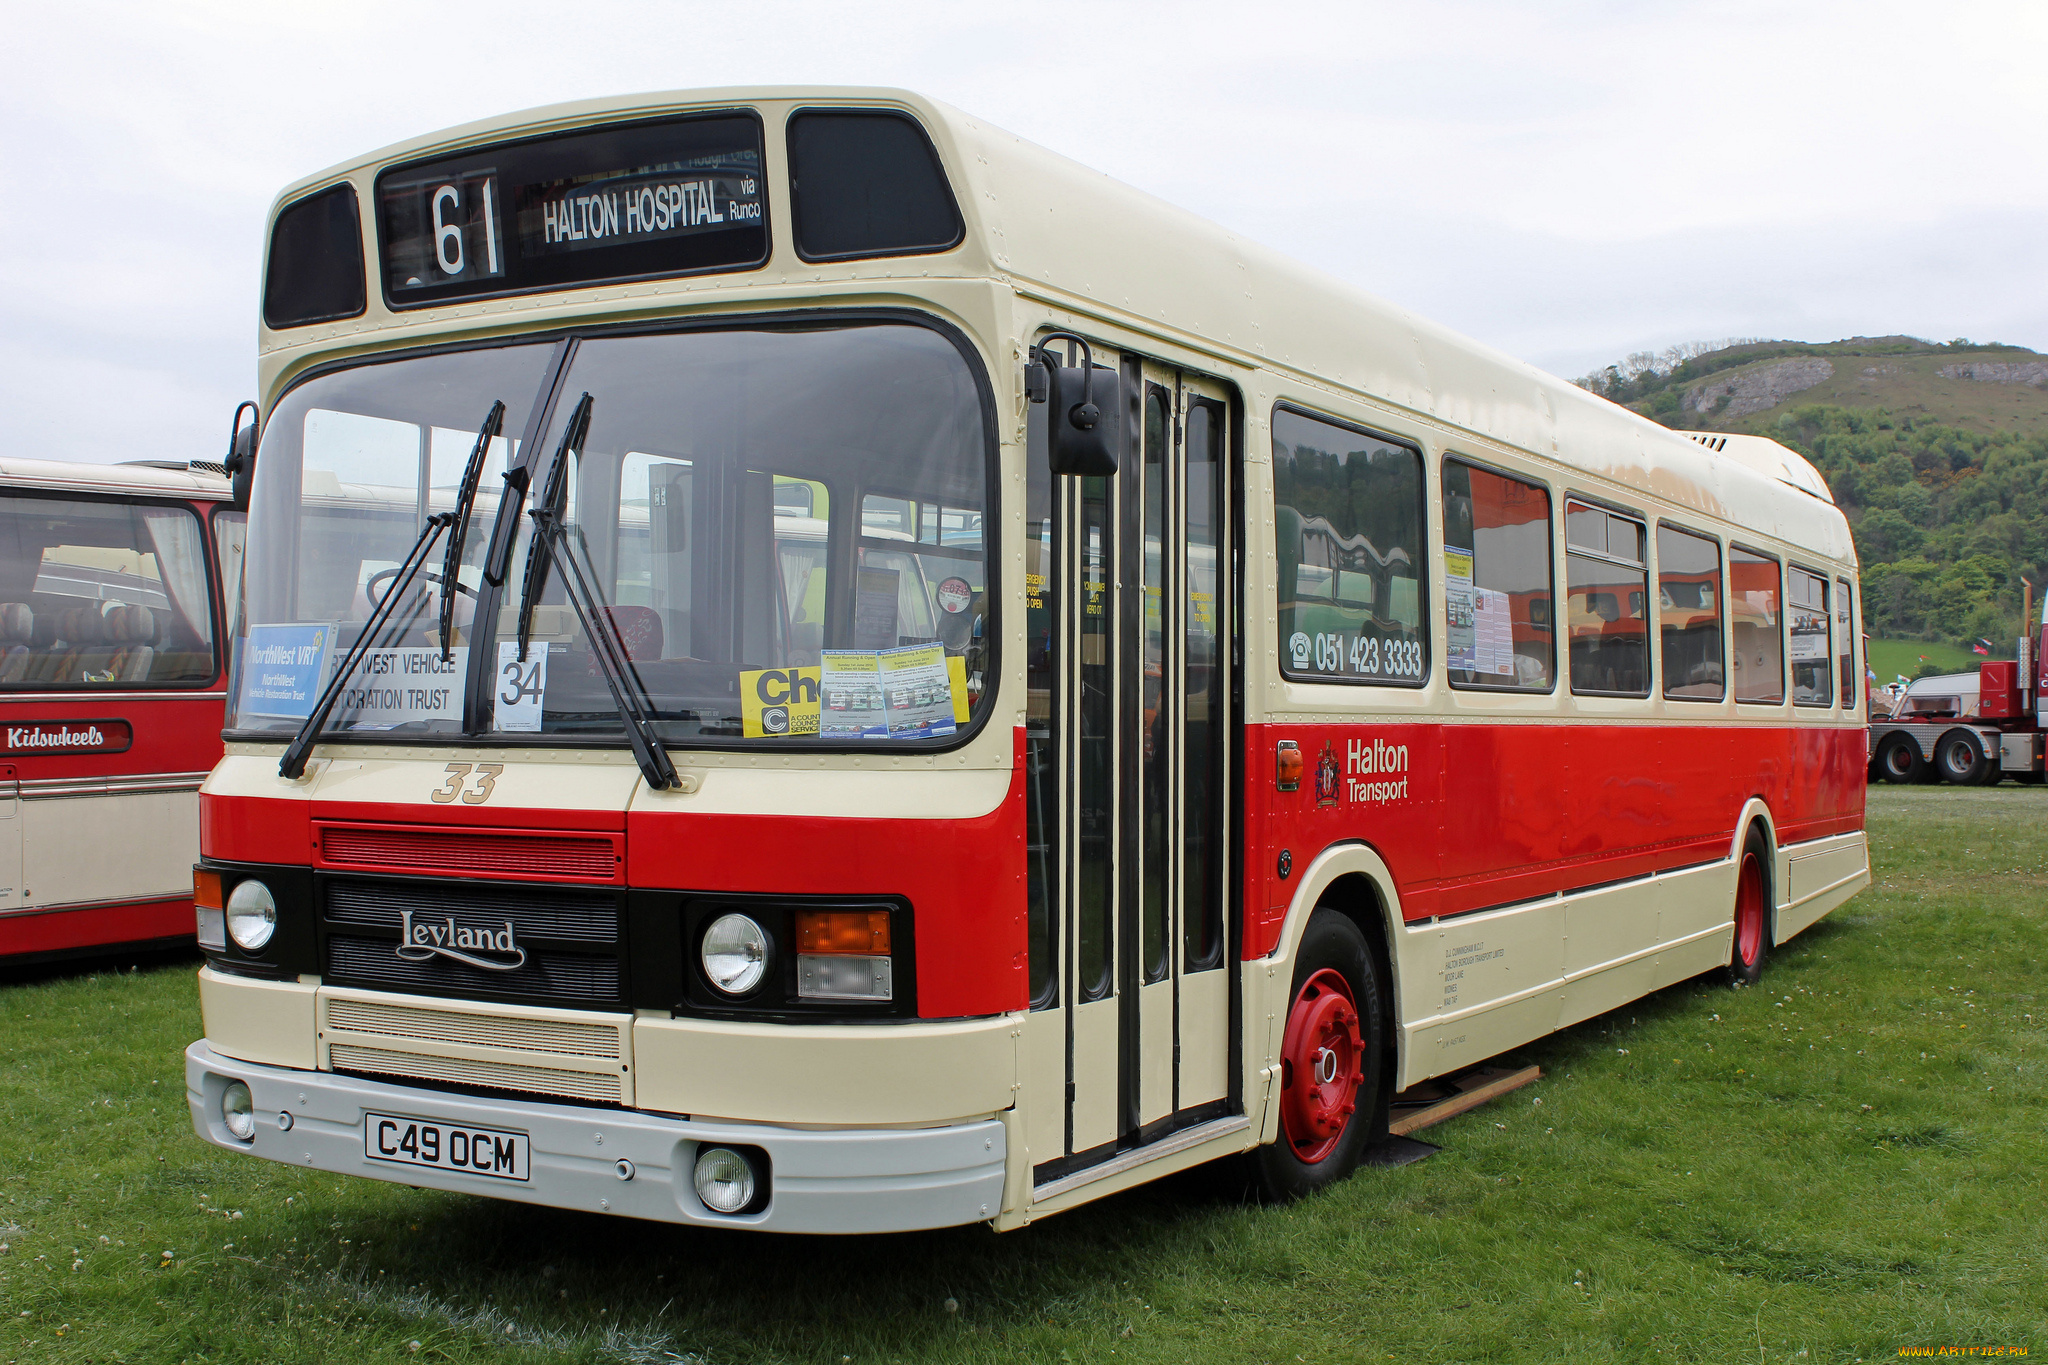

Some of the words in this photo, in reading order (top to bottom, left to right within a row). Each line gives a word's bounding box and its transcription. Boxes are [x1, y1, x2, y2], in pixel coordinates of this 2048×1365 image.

[740, 175, 755, 195] via
[543, 193, 619, 243] HALTON
[625, 180, 723, 234] HOSPITAL
[729, 200, 761, 221] Runco
[432, 177, 498, 275] 61
[1030, 598, 1043, 609] OPEN
[249, 644, 296, 665] NorthWest
[297, 646, 318, 665] VRT
[361, 654, 397, 674] WEST
[403, 653, 456, 674] VEHICLE
[1315, 632, 1344, 671] 051
[1349, 636, 1380, 674] 423
[1384, 638, 1422, 677] 3333
[249, 688, 265, 698] Vehicle
[265, 689, 292, 700] Restoration
[292, 691, 306, 701] Trust
[262, 673, 296, 687] NorthWest
[501, 662, 543, 705] 34
[757, 669, 821, 705] Ch
[408, 689, 450, 710] TRUST
[7, 726, 104, 749] Kidswheels
[1347, 738, 1408, 774] Halton
[431, 763, 504, 804] 33
[1347, 776, 1408, 805] Transport
[399, 910, 518, 956] Leyland
[379, 1120, 440, 1162] C49
[450, 1131, 514, 1174] OCM
